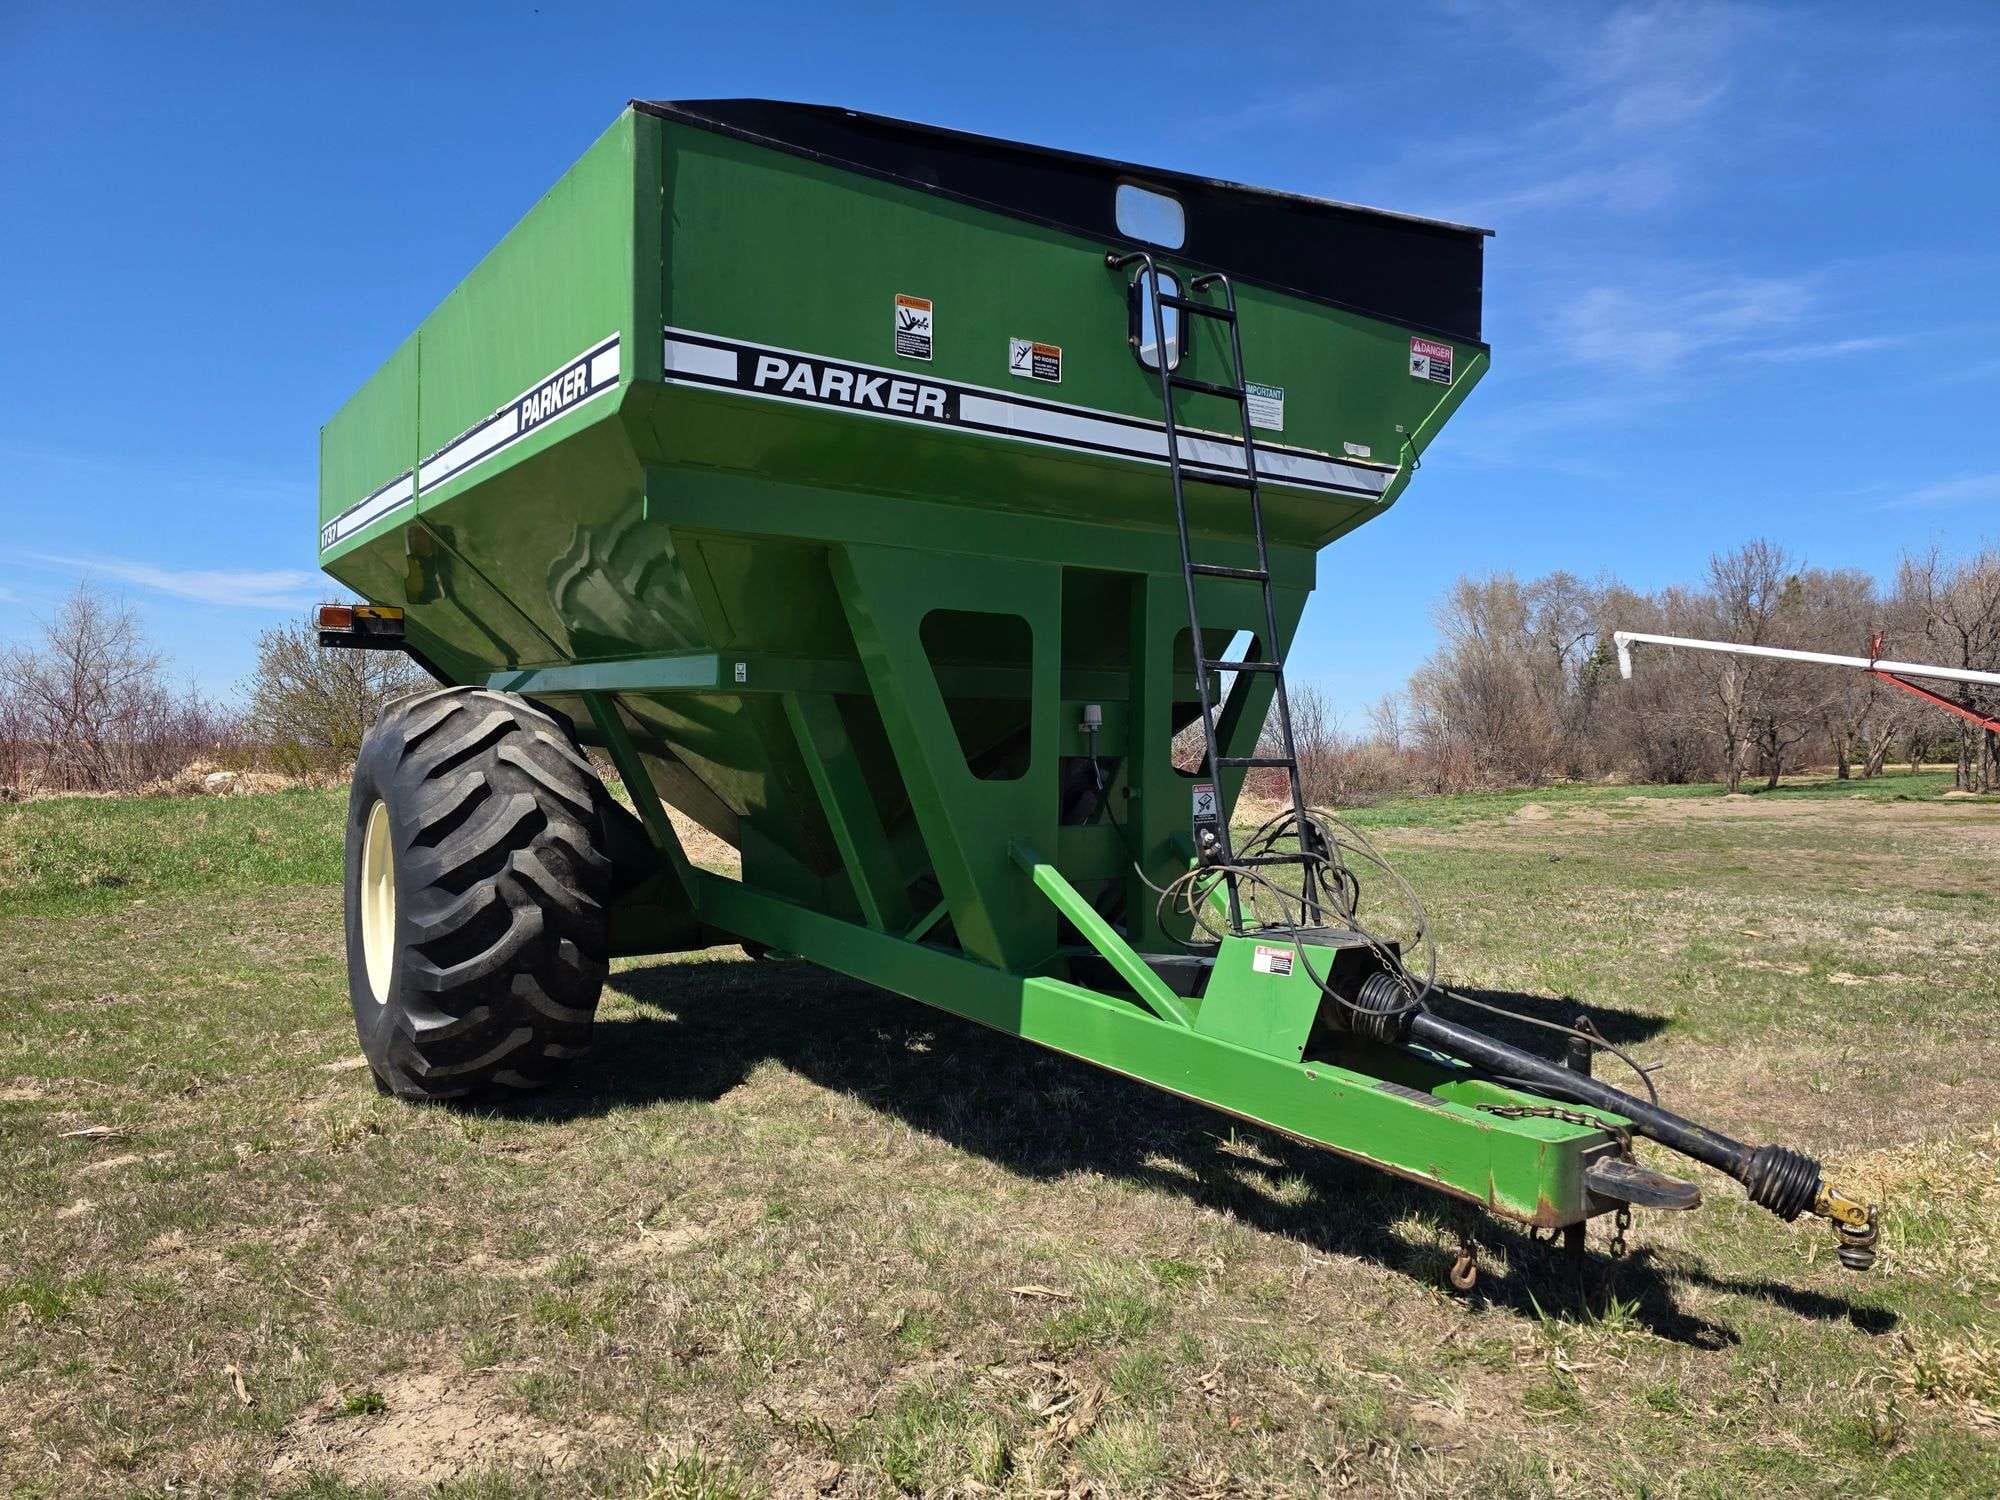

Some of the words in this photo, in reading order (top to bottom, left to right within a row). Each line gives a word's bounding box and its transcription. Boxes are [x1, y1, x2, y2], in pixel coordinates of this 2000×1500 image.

[1421, 342, 1450, 359] DANGER
[521, 363, 587, 431] PARKER
[753, 355, 947, 419] PARKER
[1245, 384, 1281, 400] IMPORTANT
